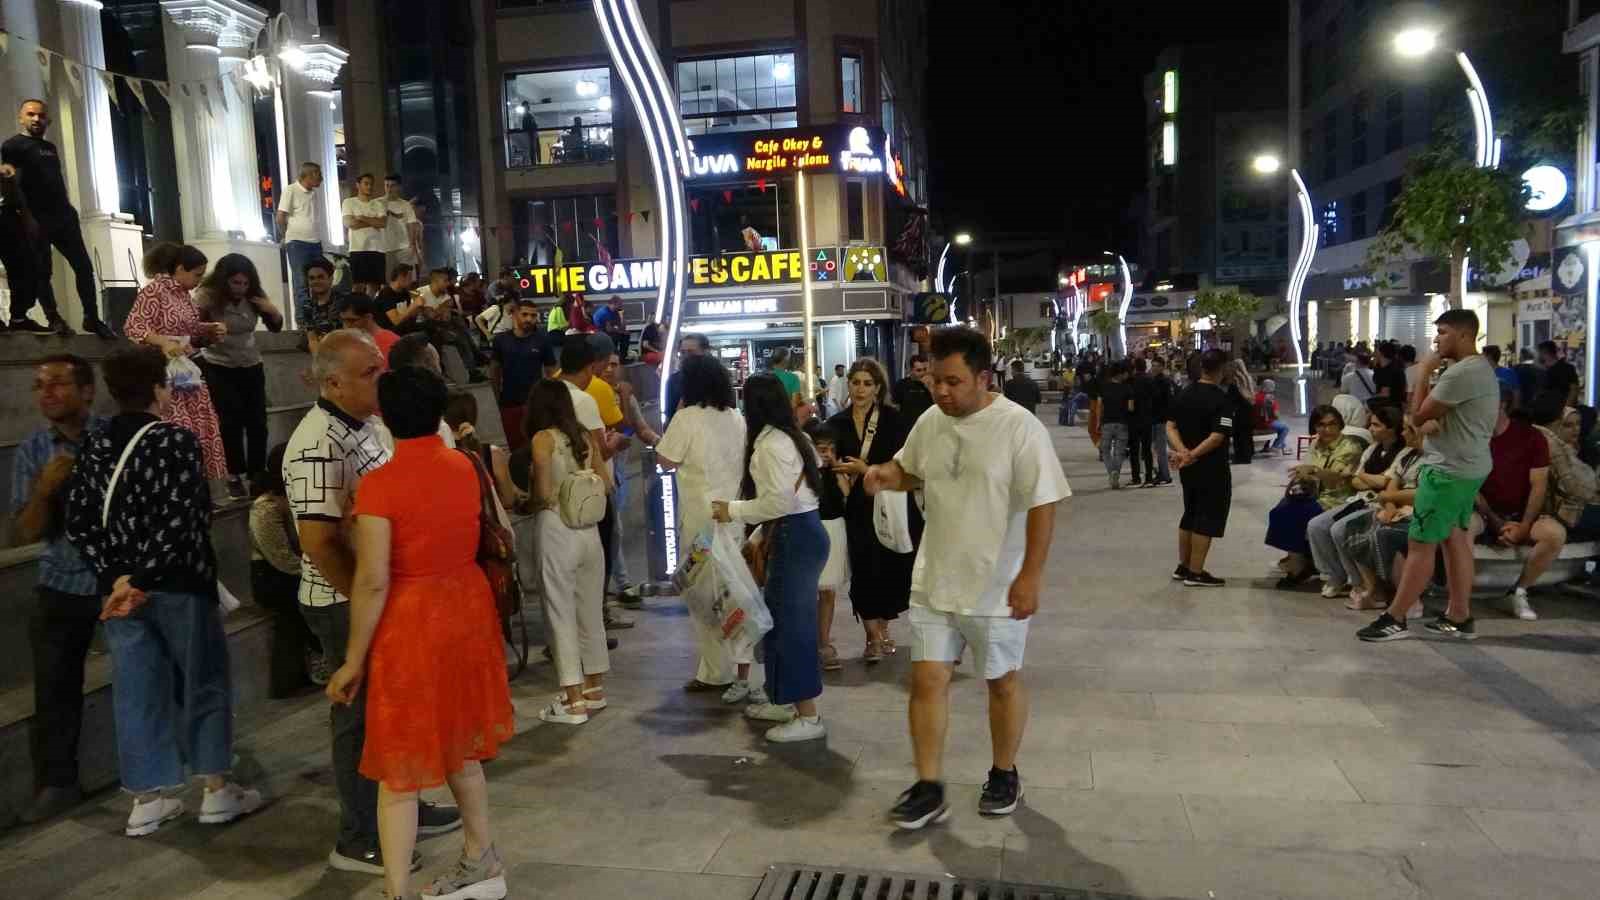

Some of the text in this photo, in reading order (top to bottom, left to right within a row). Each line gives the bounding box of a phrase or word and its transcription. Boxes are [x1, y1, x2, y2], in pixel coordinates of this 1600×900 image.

[754, 136, 823, 155] Cafe Okey &
[746, 155, 787, 171] Nargile
[530, 267, 586, 294] THE
[731, 252, 802, 283] CAFE
